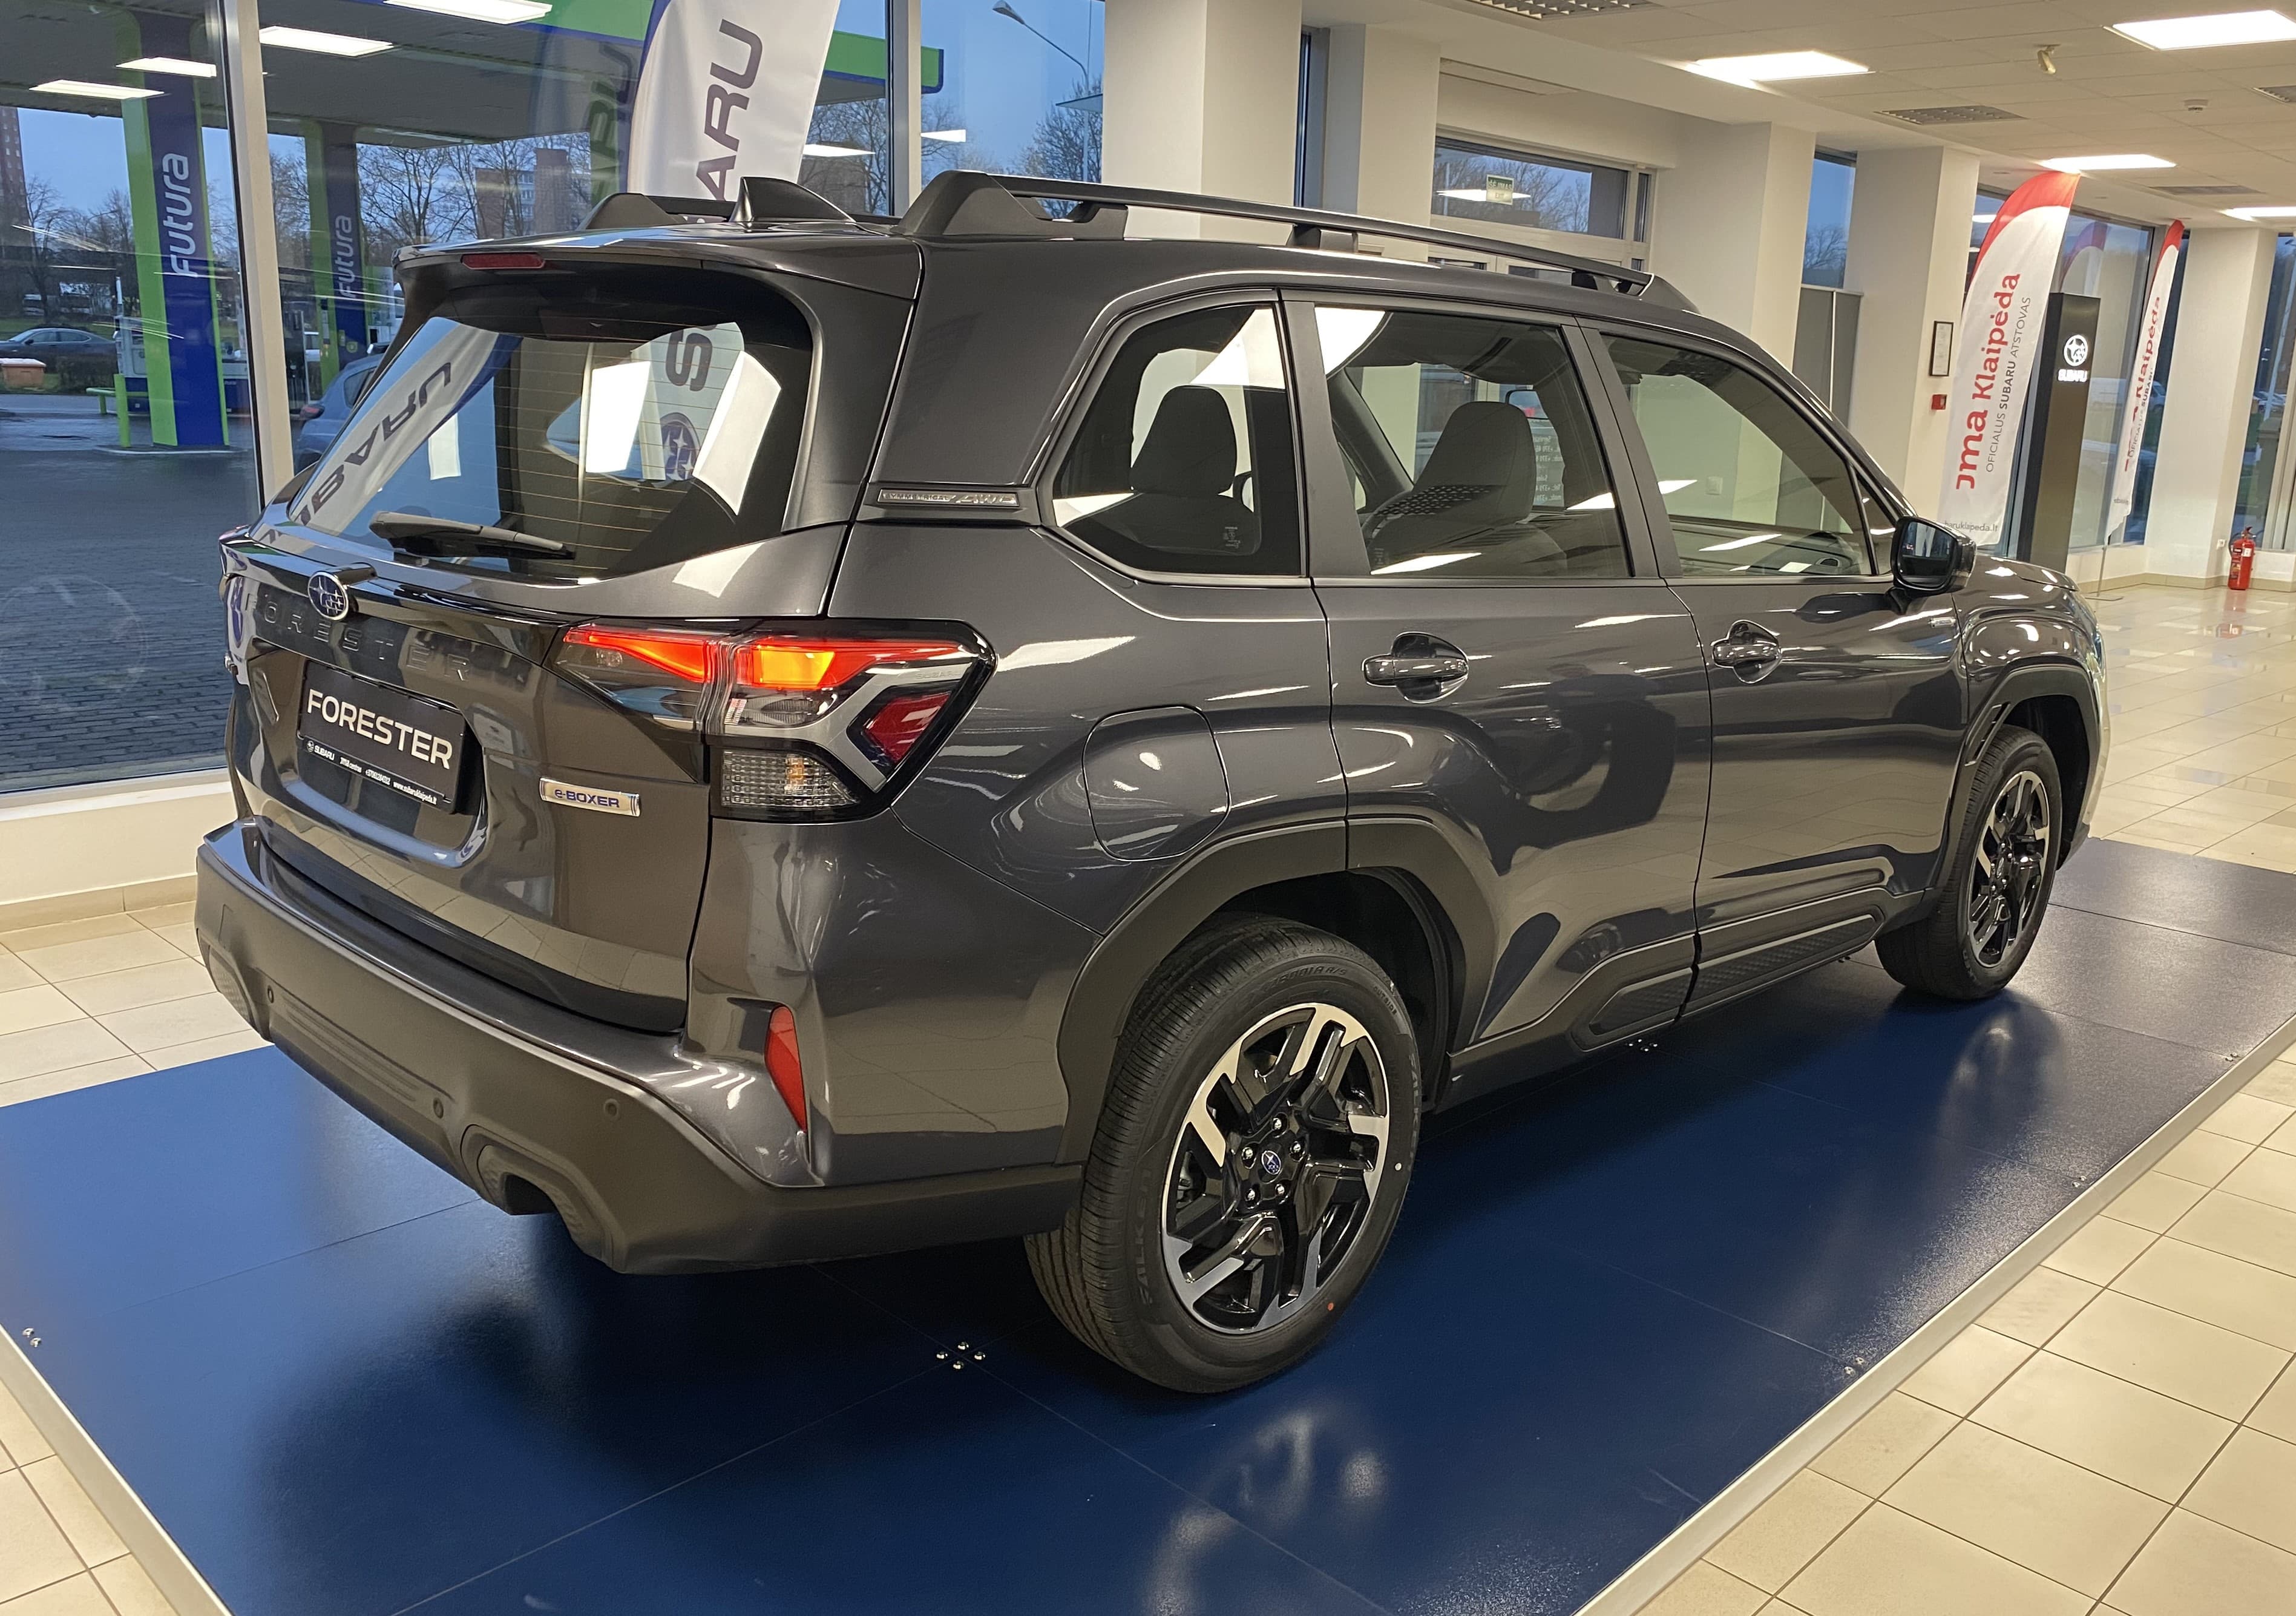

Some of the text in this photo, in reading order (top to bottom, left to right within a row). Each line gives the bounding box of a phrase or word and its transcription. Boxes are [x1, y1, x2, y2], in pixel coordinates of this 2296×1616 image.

[1972, 274, 2021, 400] Klaipėda
[1986, 297, 2031, 472] OFICIALUS SUBARU ATSTOVAS
[245, 592, 470, 682] FORESTER
[307, 688, 453, 770] FORESTER
[314, 744, 335, 761] SUBARU
[554, 789, 620, 808] e-BOXER
